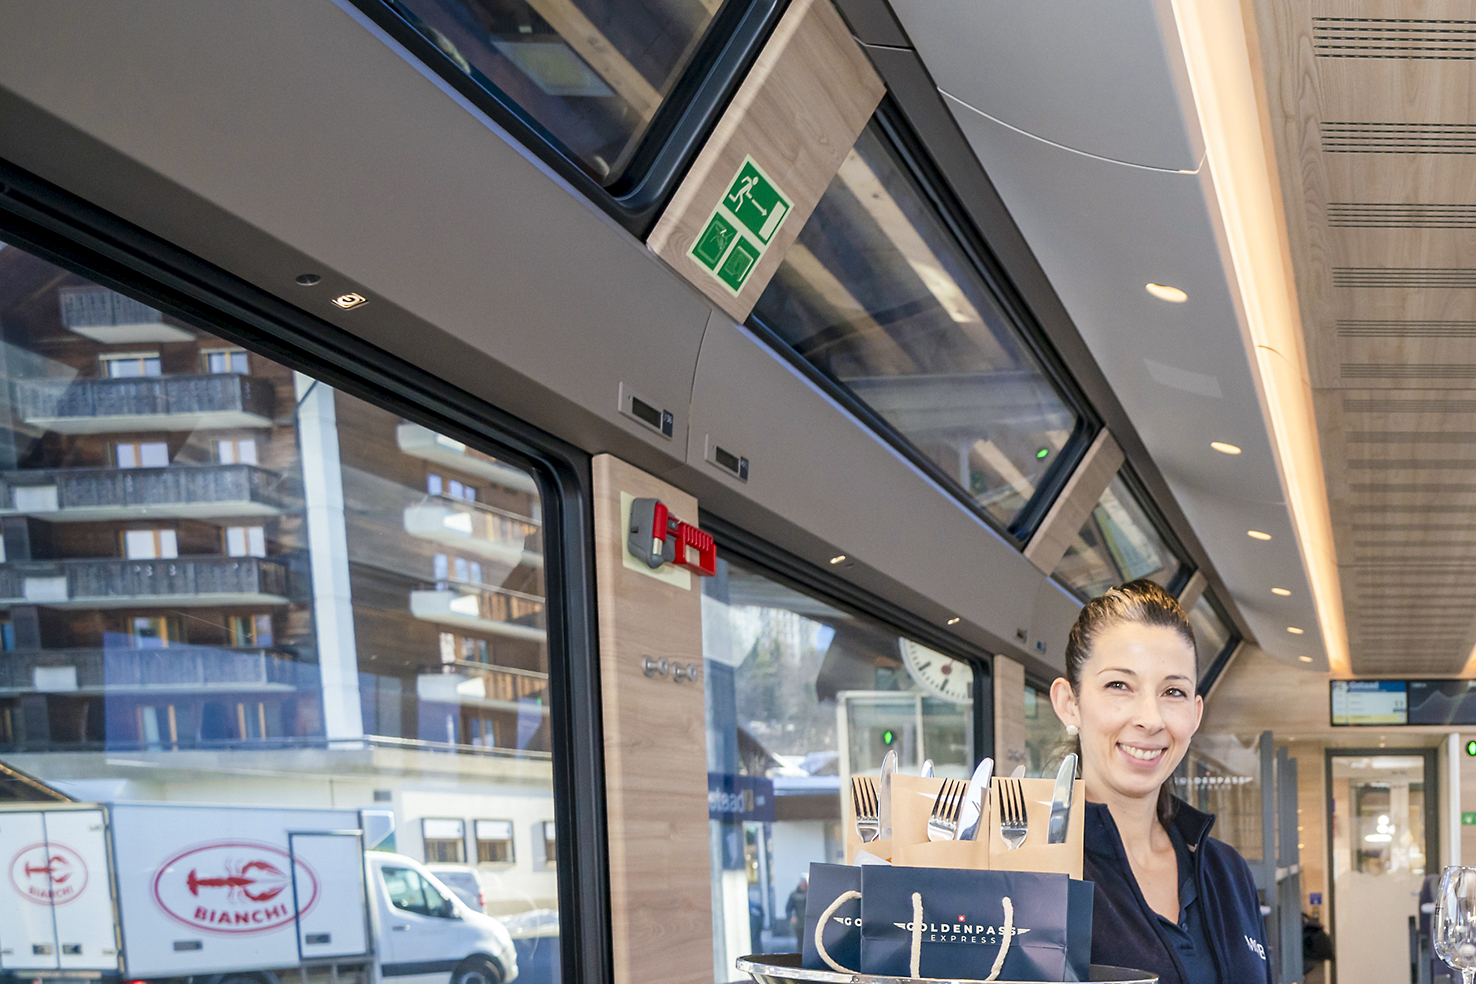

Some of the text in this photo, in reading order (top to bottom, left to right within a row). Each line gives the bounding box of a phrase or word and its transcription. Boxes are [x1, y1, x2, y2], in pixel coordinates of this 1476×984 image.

[29, 885, 75, 899] BIANCHI
[194, 903, 288, 924] BIANCHI
[844, 916, 863, 927] GO
[906, 922, 1017, 936] GOLDENPASS
[930, 934, 996, 944] EXPRESS
[1244, 934, 1267, 960] MB
